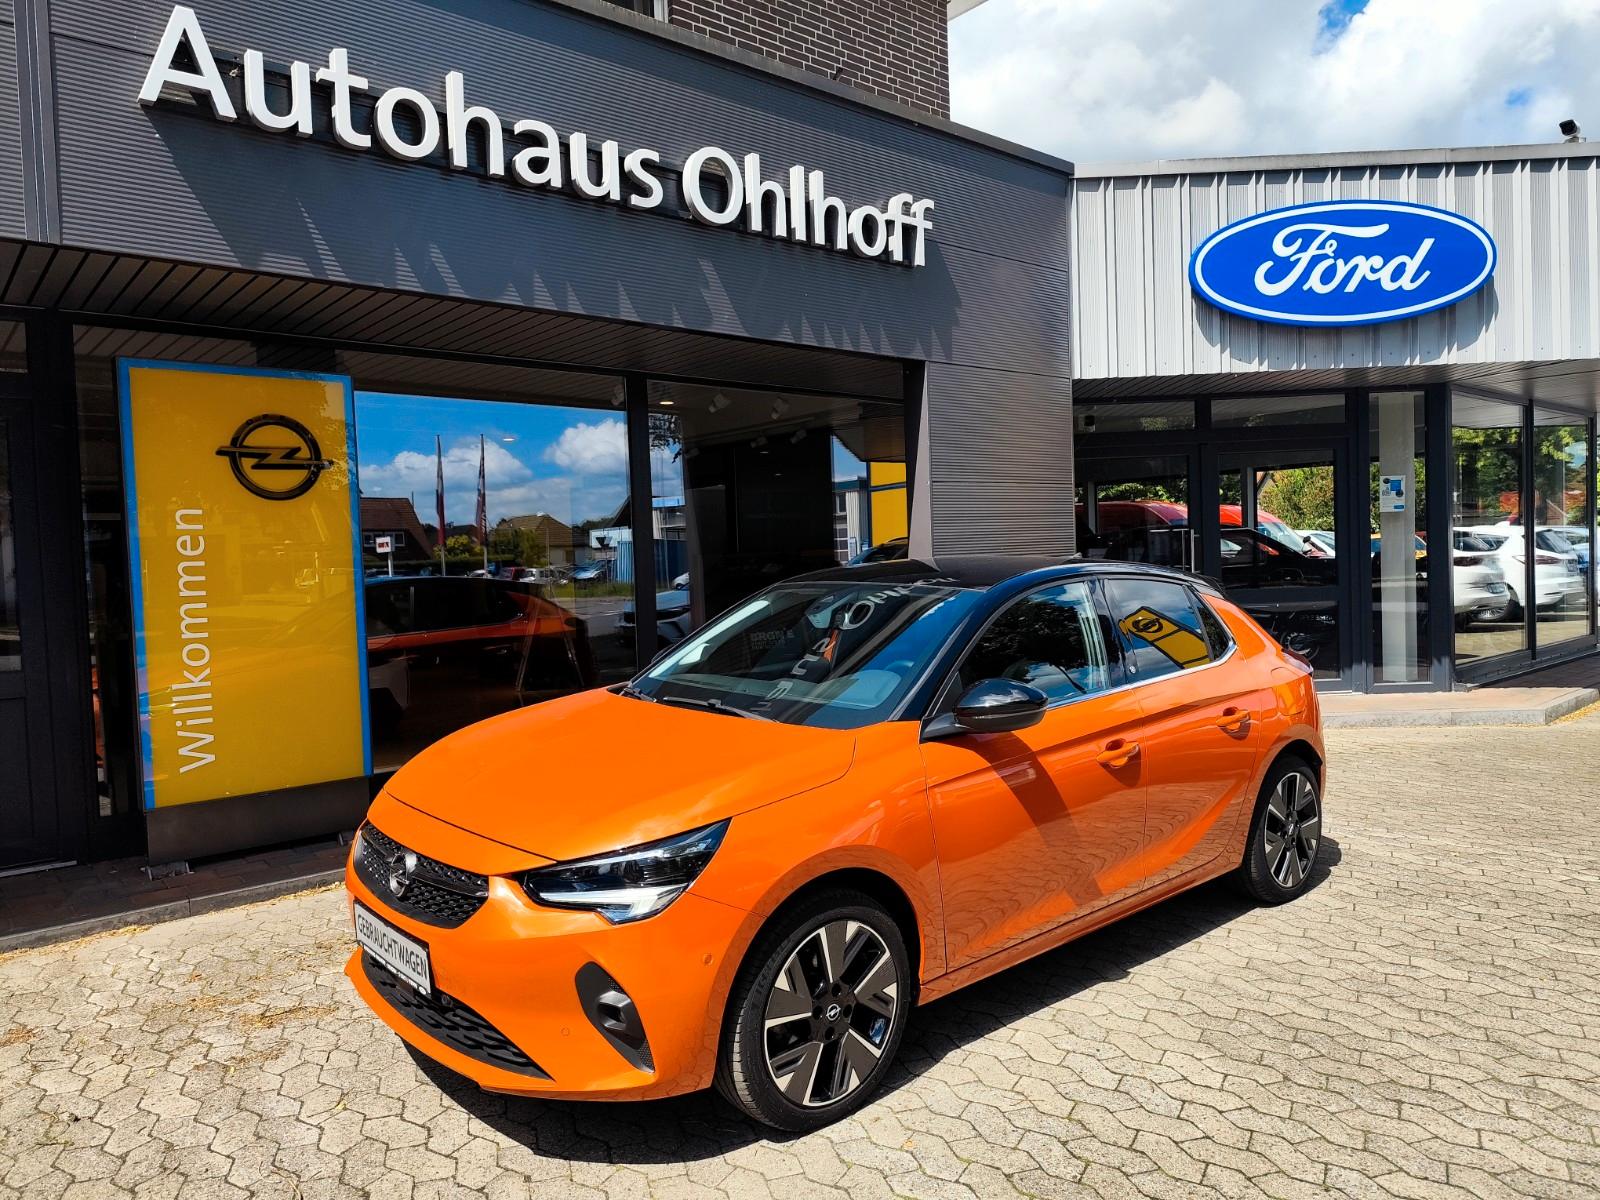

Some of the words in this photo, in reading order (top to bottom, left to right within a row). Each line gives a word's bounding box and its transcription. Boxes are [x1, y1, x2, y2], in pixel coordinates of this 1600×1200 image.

[137, 5, 663, 209] Autohaus
[682, 146, 934, 268] Ohlhoff
[1254, 223, 1436, 296] Ford
[174, 507, 216, 774] Willkommen
[357, 913, 428, 980] GEBRAUCHTWAGEN
